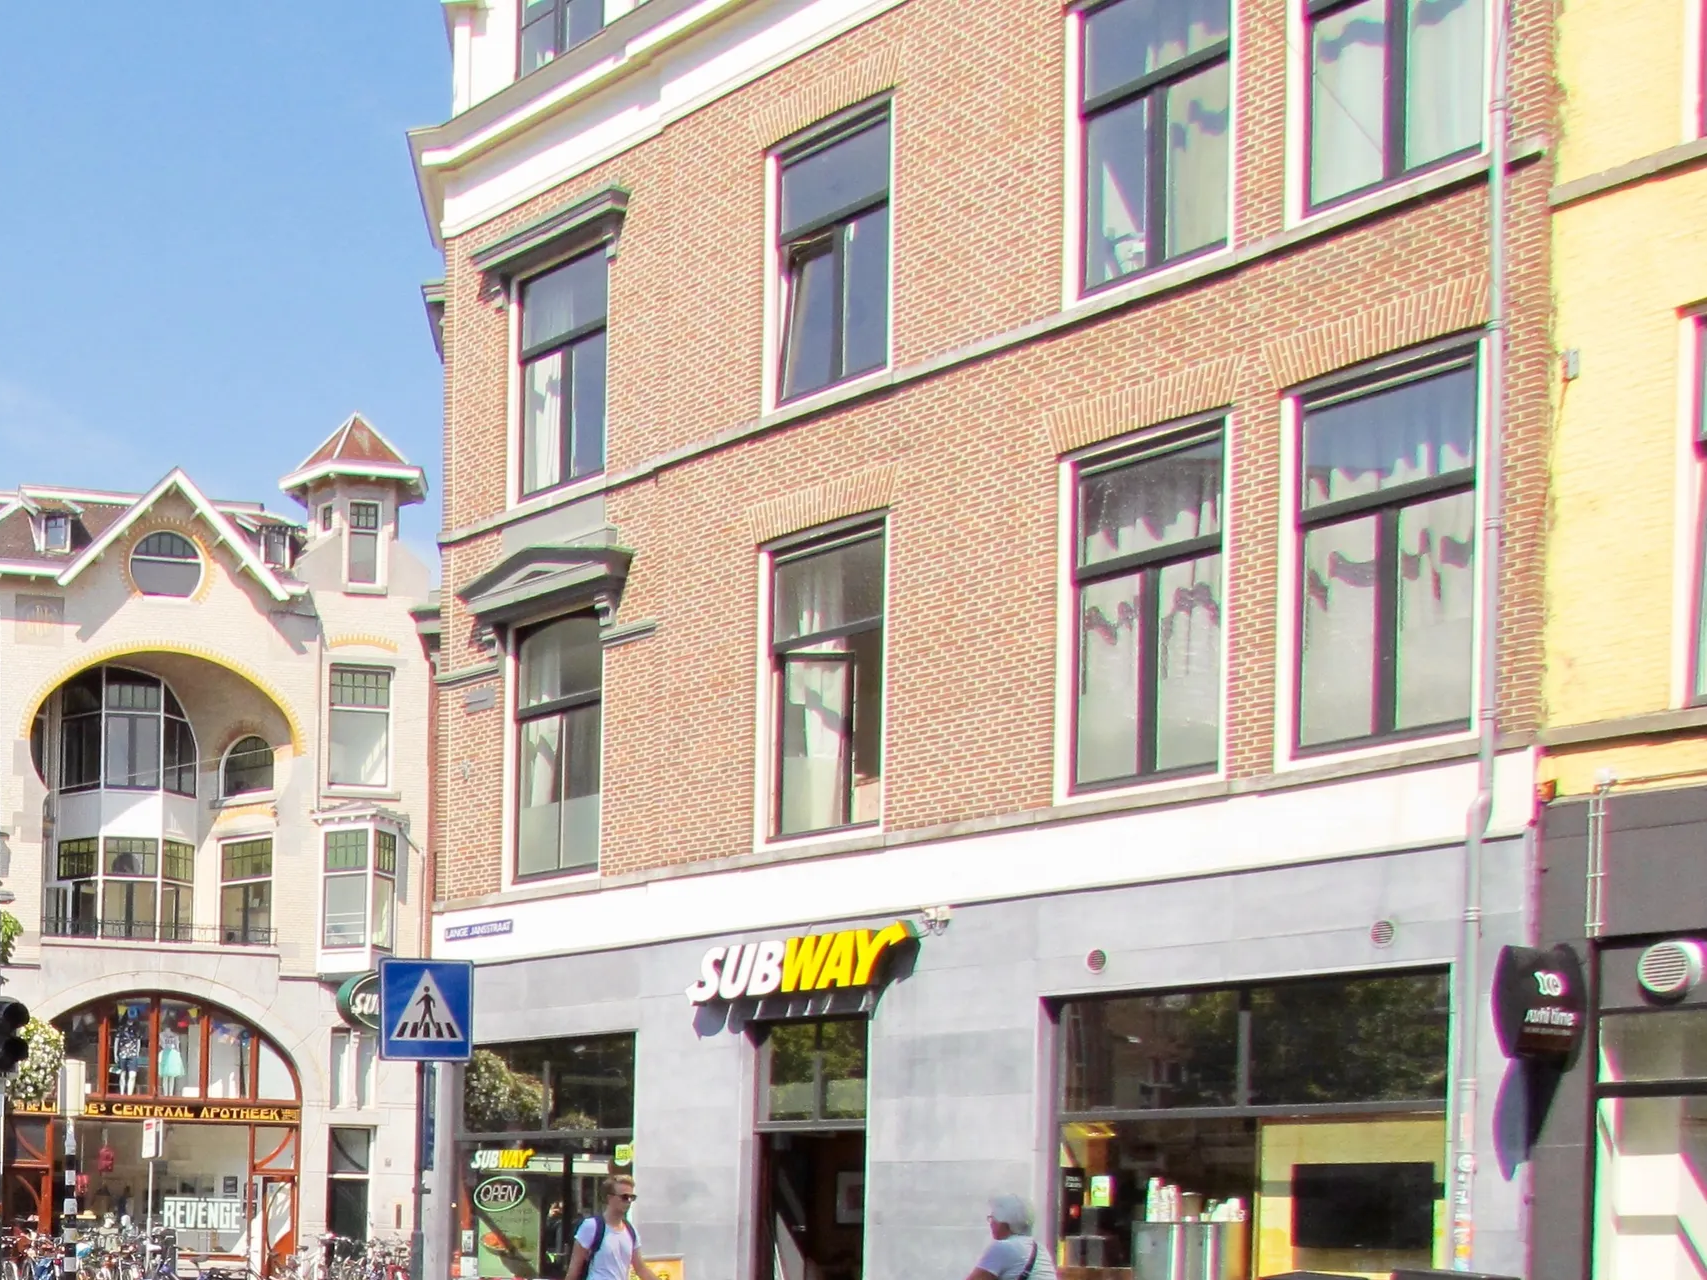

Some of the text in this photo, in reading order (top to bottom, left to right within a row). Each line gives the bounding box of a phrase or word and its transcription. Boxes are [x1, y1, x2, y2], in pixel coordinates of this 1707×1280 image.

[446, 920, 513, 940] LANGE JANSSTRAAT
[685, 920, 908, 1006] SUBWAY
[1524, 1006, 1575, 1026] sushi time
[112, 1103, 195, 1119] CENTRAAL
[199, 1106, 281, 1121] APOTHEEK
[470, 1148, 536, 1169] SUBWAY
[479, 1184, 519, 1203] OPEN
